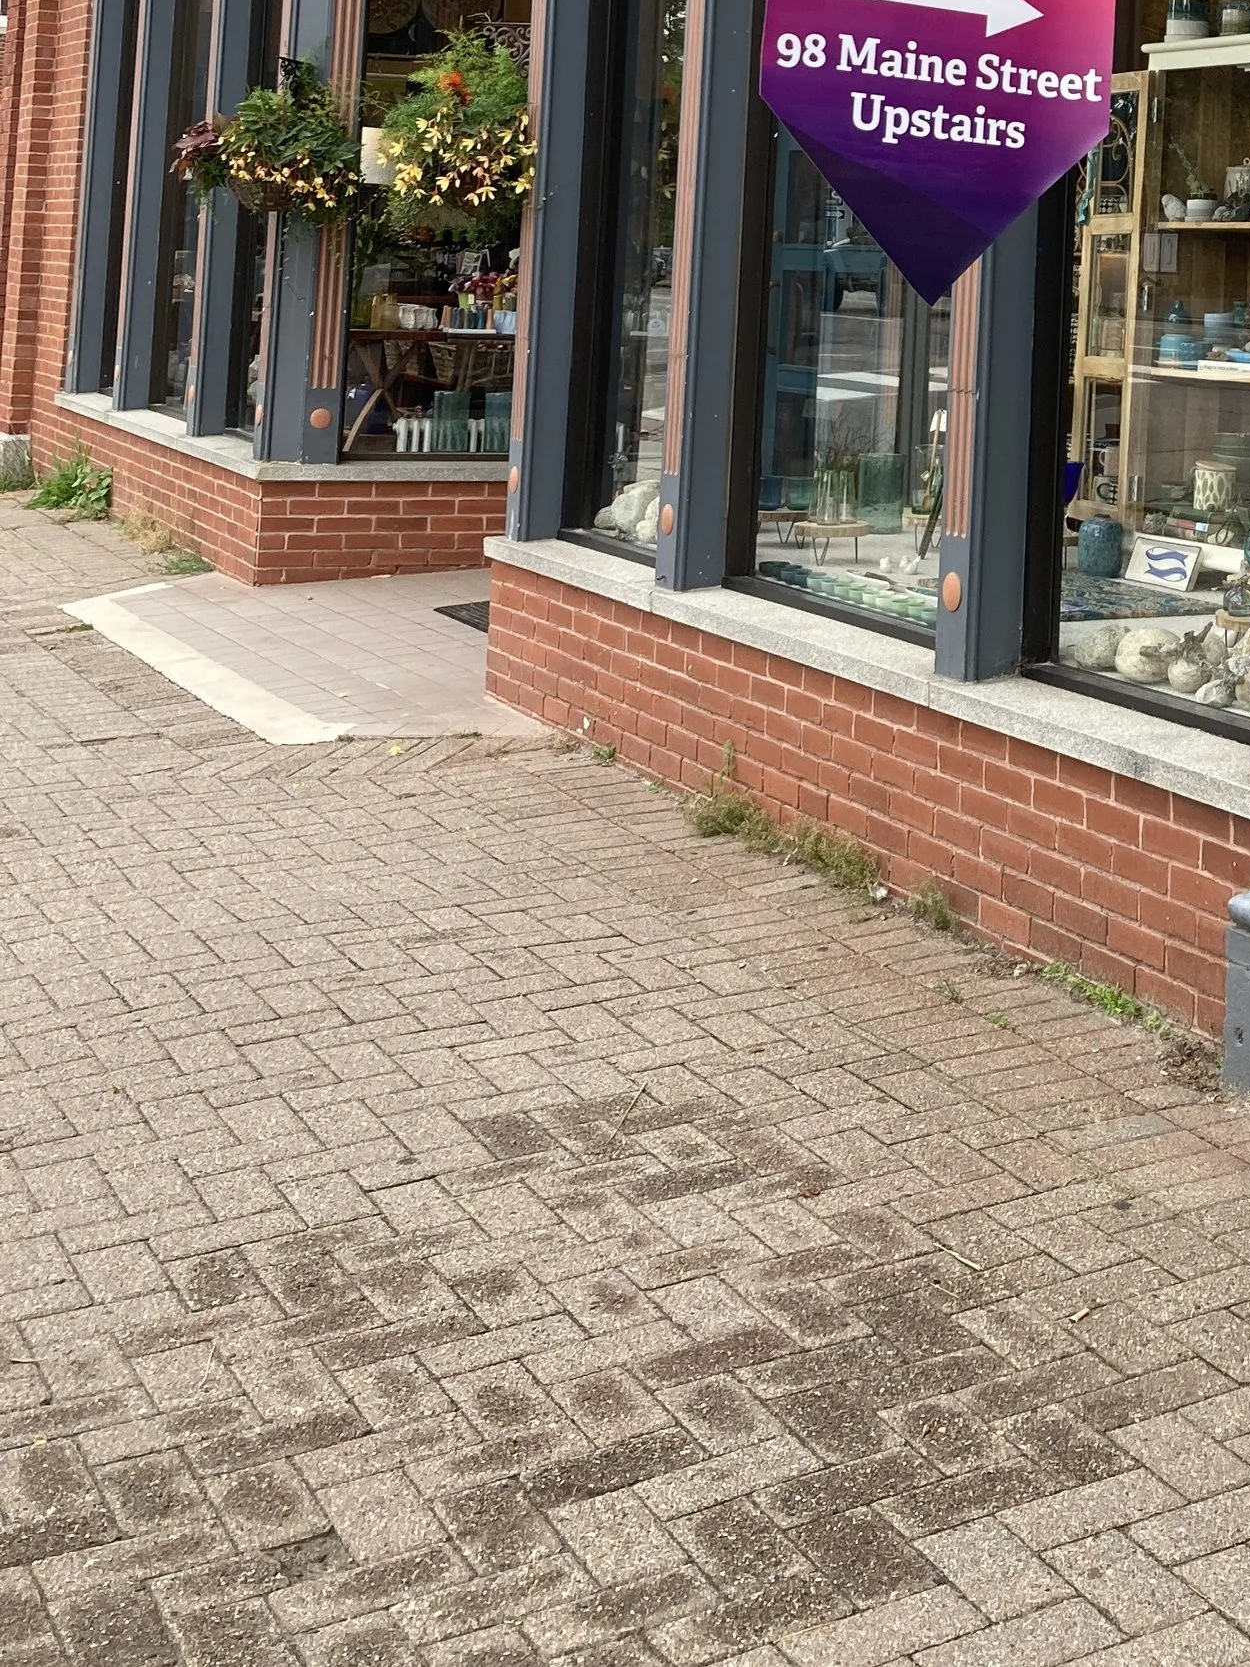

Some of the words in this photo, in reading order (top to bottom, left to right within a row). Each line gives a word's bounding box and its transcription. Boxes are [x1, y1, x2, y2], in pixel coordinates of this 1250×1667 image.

[775, 33, 827, 69] 98
[836, 33, 968, 87] Maine
[975, 53, 1103, 102] Street
[850, 91, 1026, 149] Upstairs
